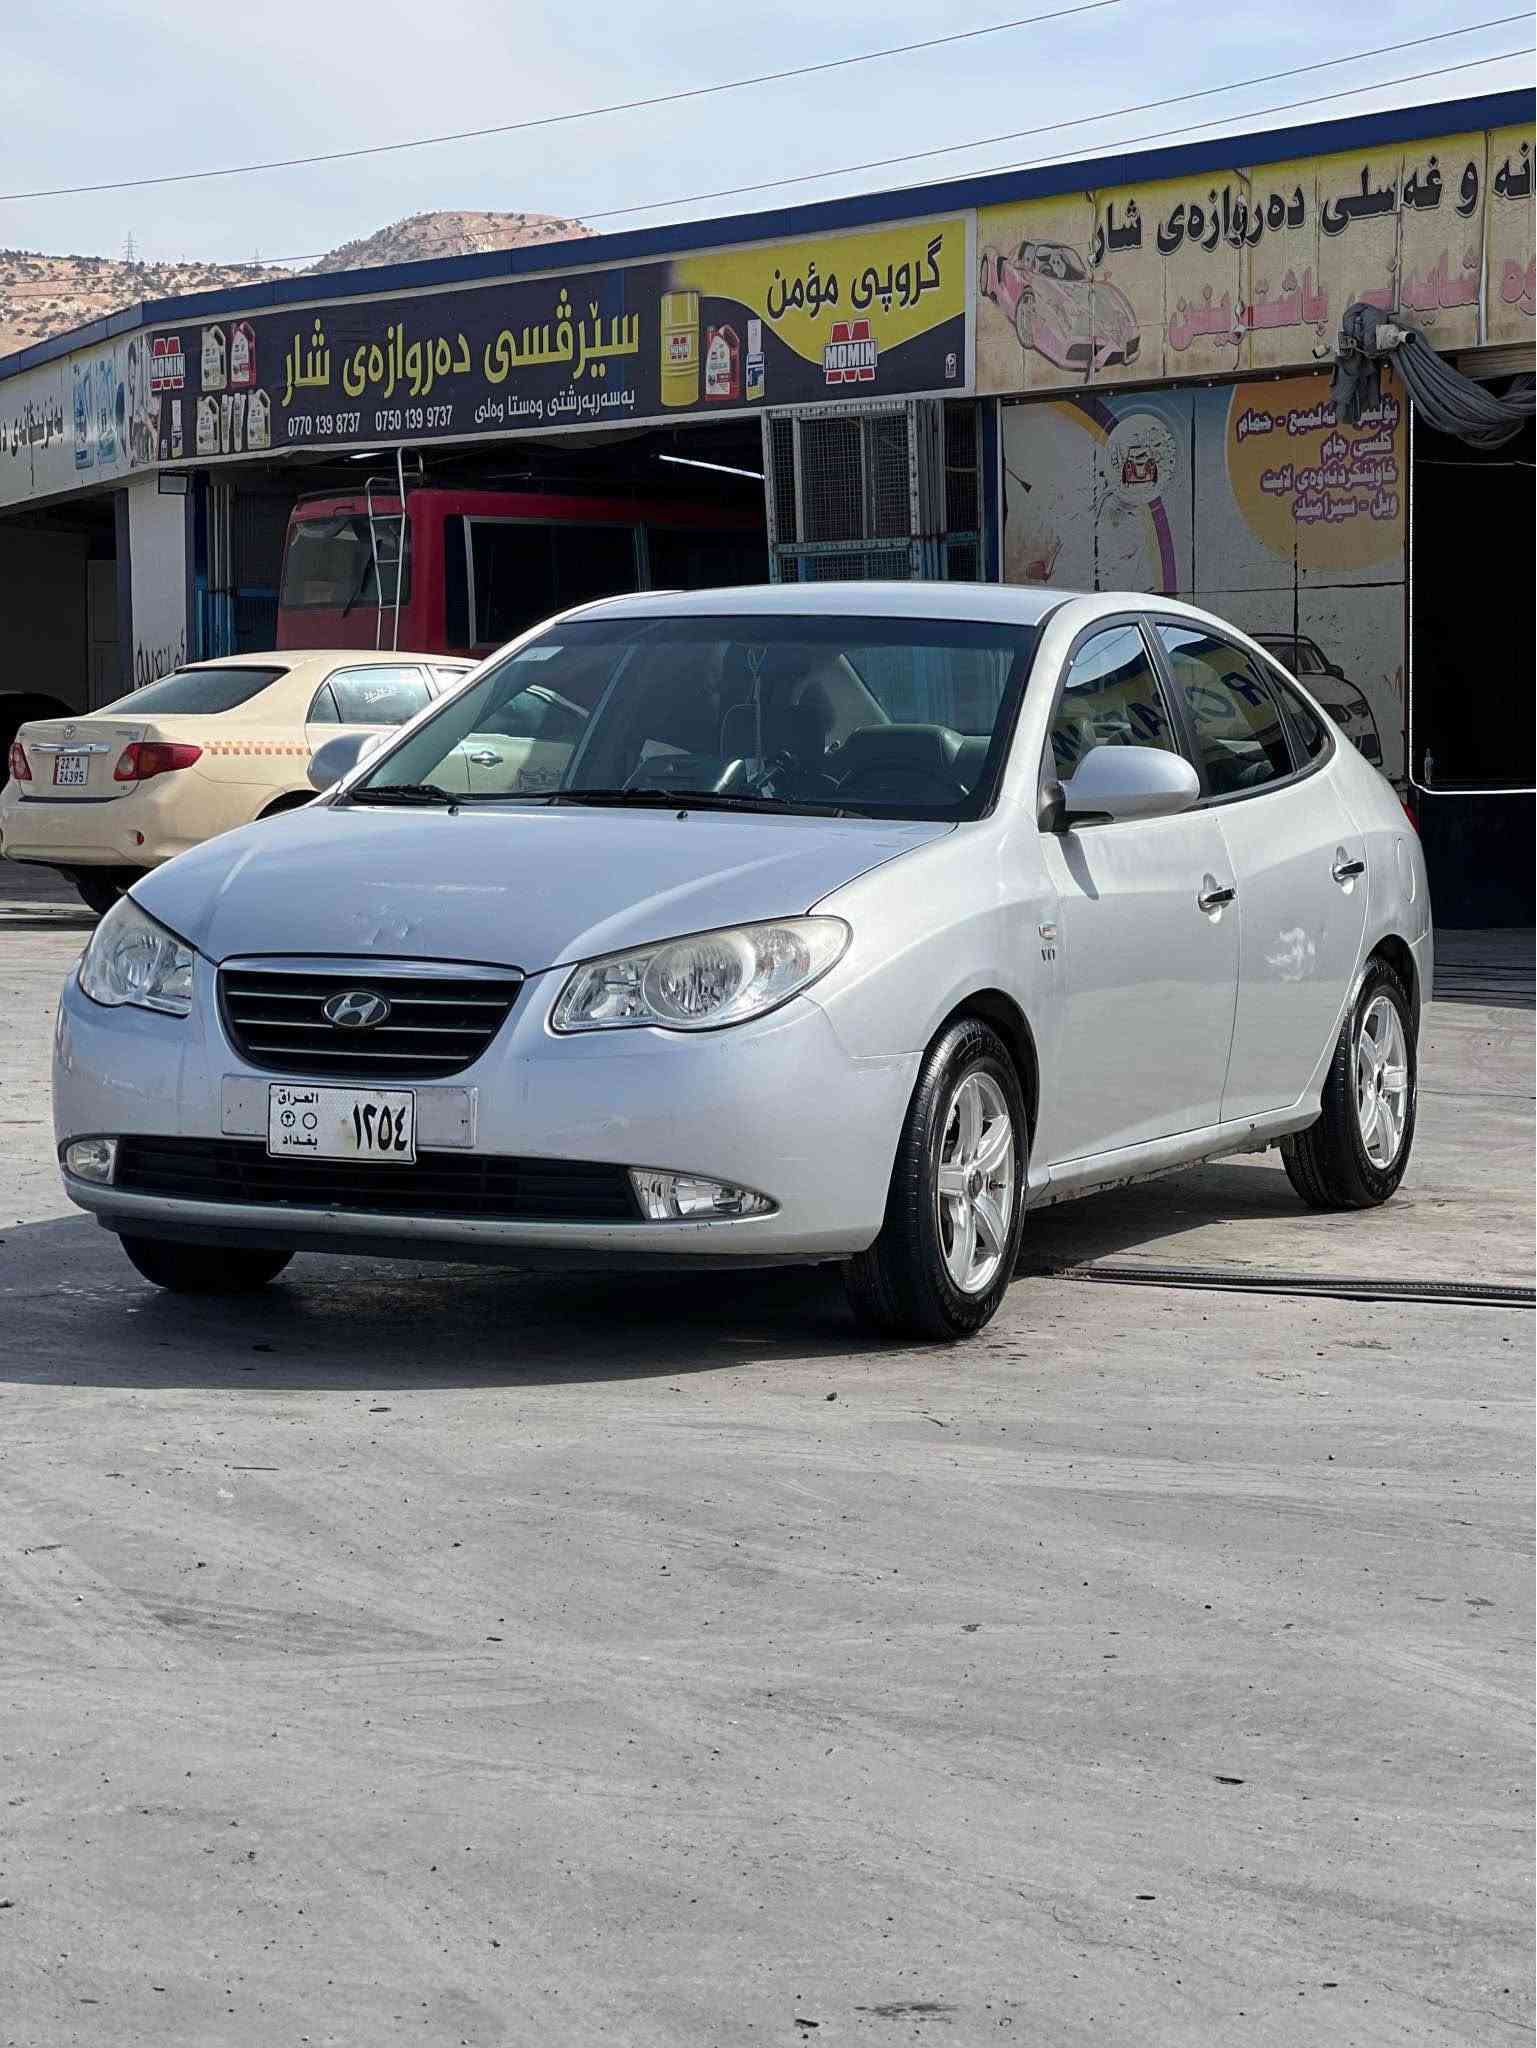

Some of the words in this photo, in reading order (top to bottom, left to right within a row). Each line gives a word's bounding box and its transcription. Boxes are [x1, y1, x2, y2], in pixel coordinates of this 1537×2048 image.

[1456, 162, 1478, 218] و
[1493, 142, 1536, 200] نە
[1091, 198, 1142, 267] شار
[1157, 184, 1305, 255] دەروازەی
[767, 262, 839, 319] مؤمن
[851, 233, 943, 313] گروپی
[282, 318, 330, 407] شار
[343, 322, 471, 399] دەروازەی
[484, 288, 639, 384] سێرڤسی
[825, 341, 875, 370] MOMIN
[151, 354, 185, 379] MOMIN
[288, 416, 312, 437] 0770
[315, 414, 333, 434] 139
[336, 412, 361, 434] 8737
[375, 409, 401, 431] 0750
[405, 408, 423, 429] 139
[426, 405, 453, 428] 9737
[474, 398, 504, 423] وەلی
[508, 395, 543, 419] وەستا
[547, 384, 635, 417] بەسەرپەرشتی
[278, 1089, 319, 1106] العراق
[282, 1134, 318, 1150] بغداد
